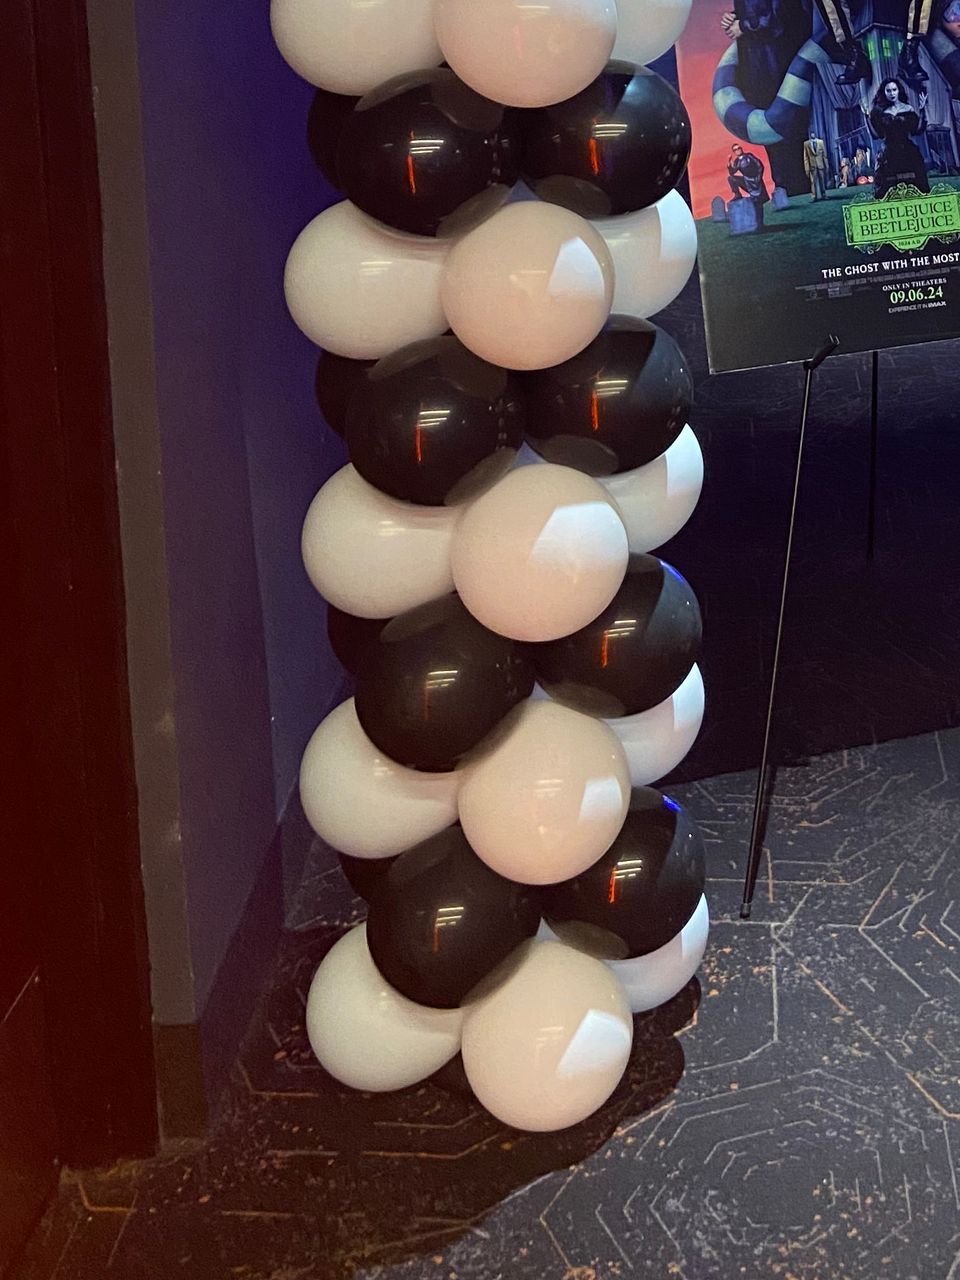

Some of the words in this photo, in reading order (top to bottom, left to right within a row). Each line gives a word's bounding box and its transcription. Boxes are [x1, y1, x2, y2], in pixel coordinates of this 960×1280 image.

[859, 201, 953, 222] BEETLEJUICE
[860, 215, 954, 236] BEETLEJUICE
[822, 267, 842, 279] THE
[844, 262, 879, 276] GHOST
[881, 258, 908, 271] WITH
[910, 256, 930, 267] THE
[932, 252, 960, 264] MOST
[882, 283, 902, 291] ONLY
[902, 281, 910, 289] IN
[911, 277, 947, 288] THEATERS
[890, 285, 944, 304] 09.06.24
[928, 300, 947, 308] IMAX
